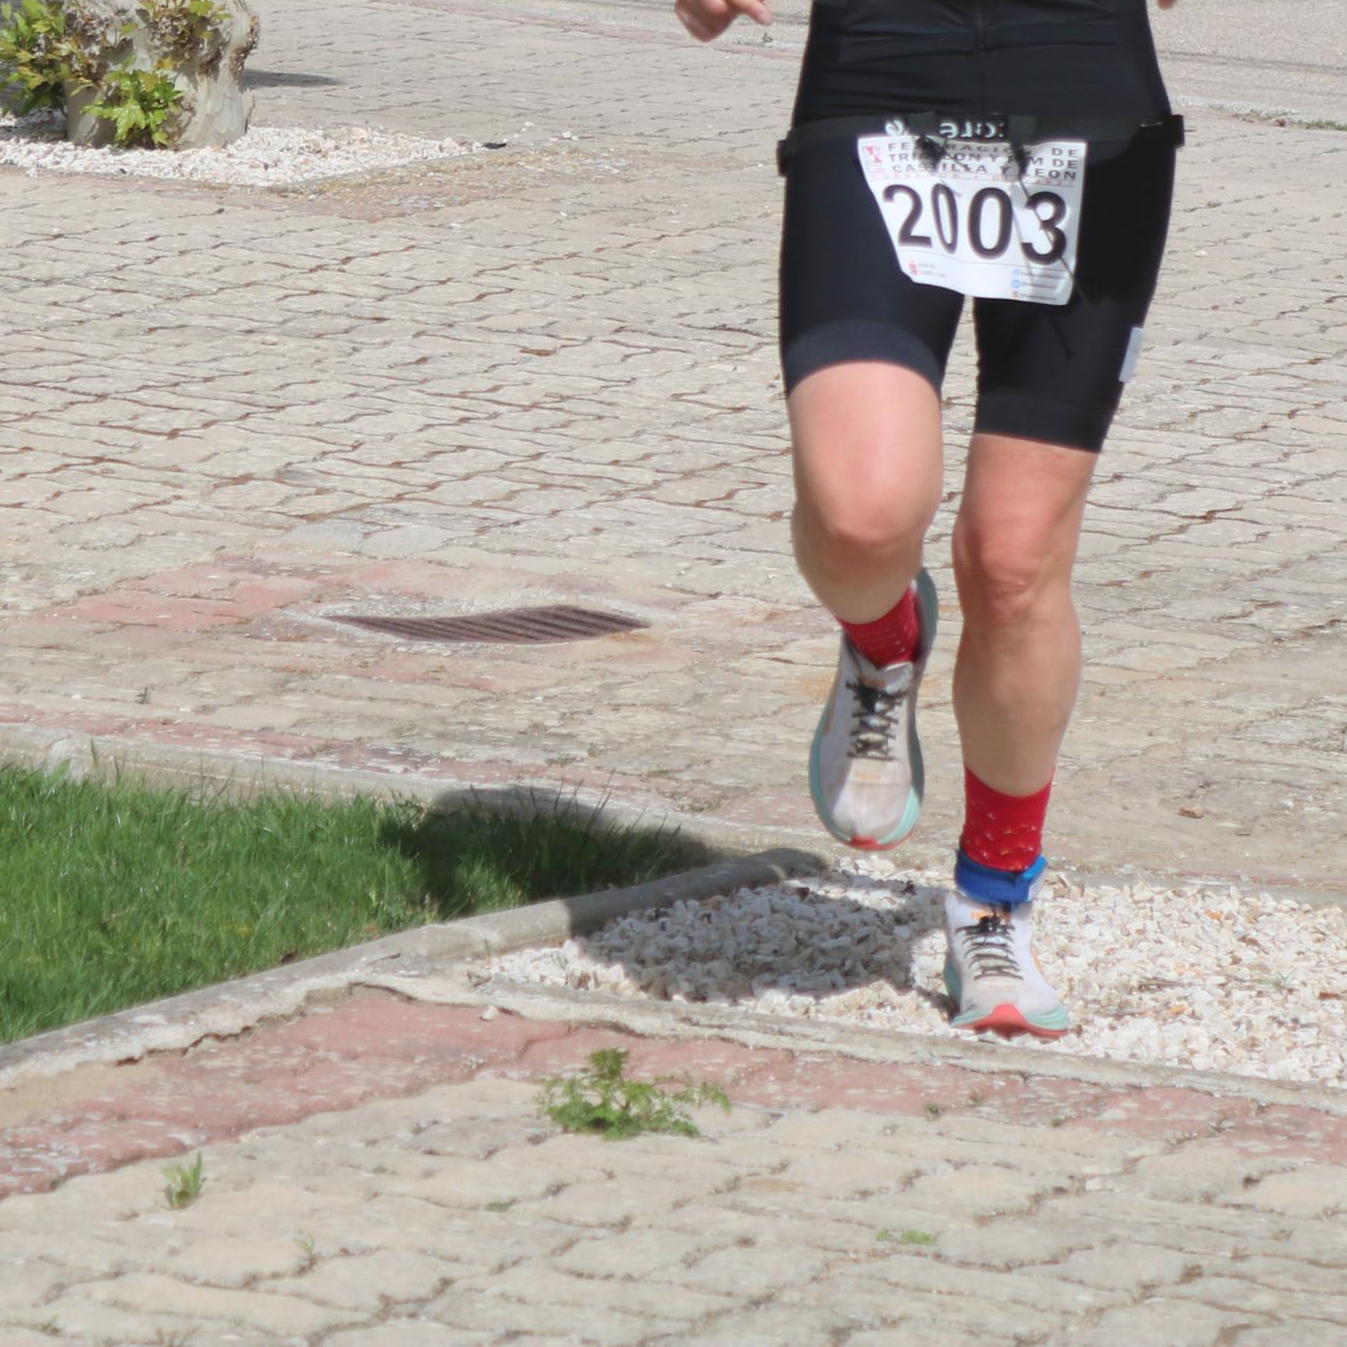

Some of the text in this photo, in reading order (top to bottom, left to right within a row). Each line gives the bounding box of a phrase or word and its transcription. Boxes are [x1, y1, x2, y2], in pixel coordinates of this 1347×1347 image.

[888, 142, 1079, 158] FERACIO DE
[888, 153, 981, 163] TRIAON
[1052, 158, 1079, 169] DE
[1025, 168, 1077, 181] EON
[882, 183, 1067, 266] 2003
